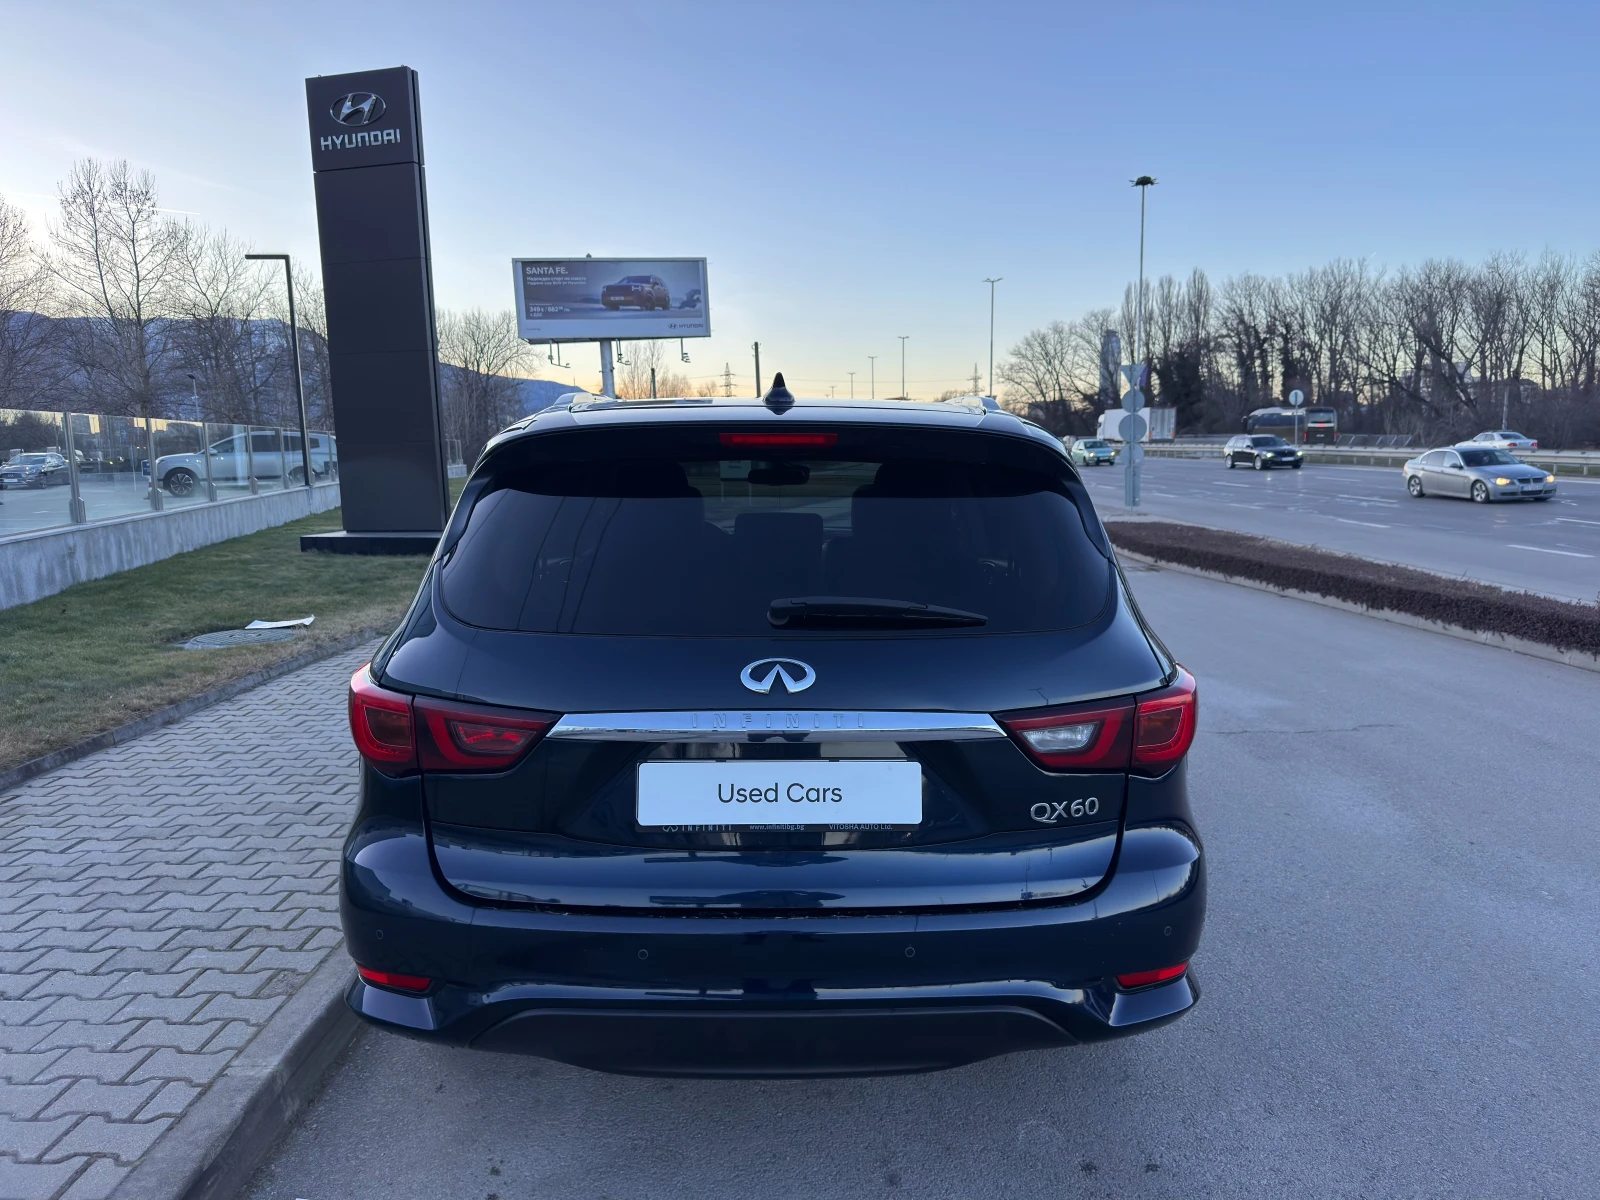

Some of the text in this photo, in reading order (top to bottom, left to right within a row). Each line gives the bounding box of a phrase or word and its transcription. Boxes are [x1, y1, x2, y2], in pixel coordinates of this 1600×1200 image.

[320, 128, 401, 151] HYUNDAI
[526, 266, 569, 275] SANTA FE.
[691, 713, 865, 729] INFINITI
[717, 782, 843, 803] Used Cars
[1030, 797, 1099, 824] QX60
